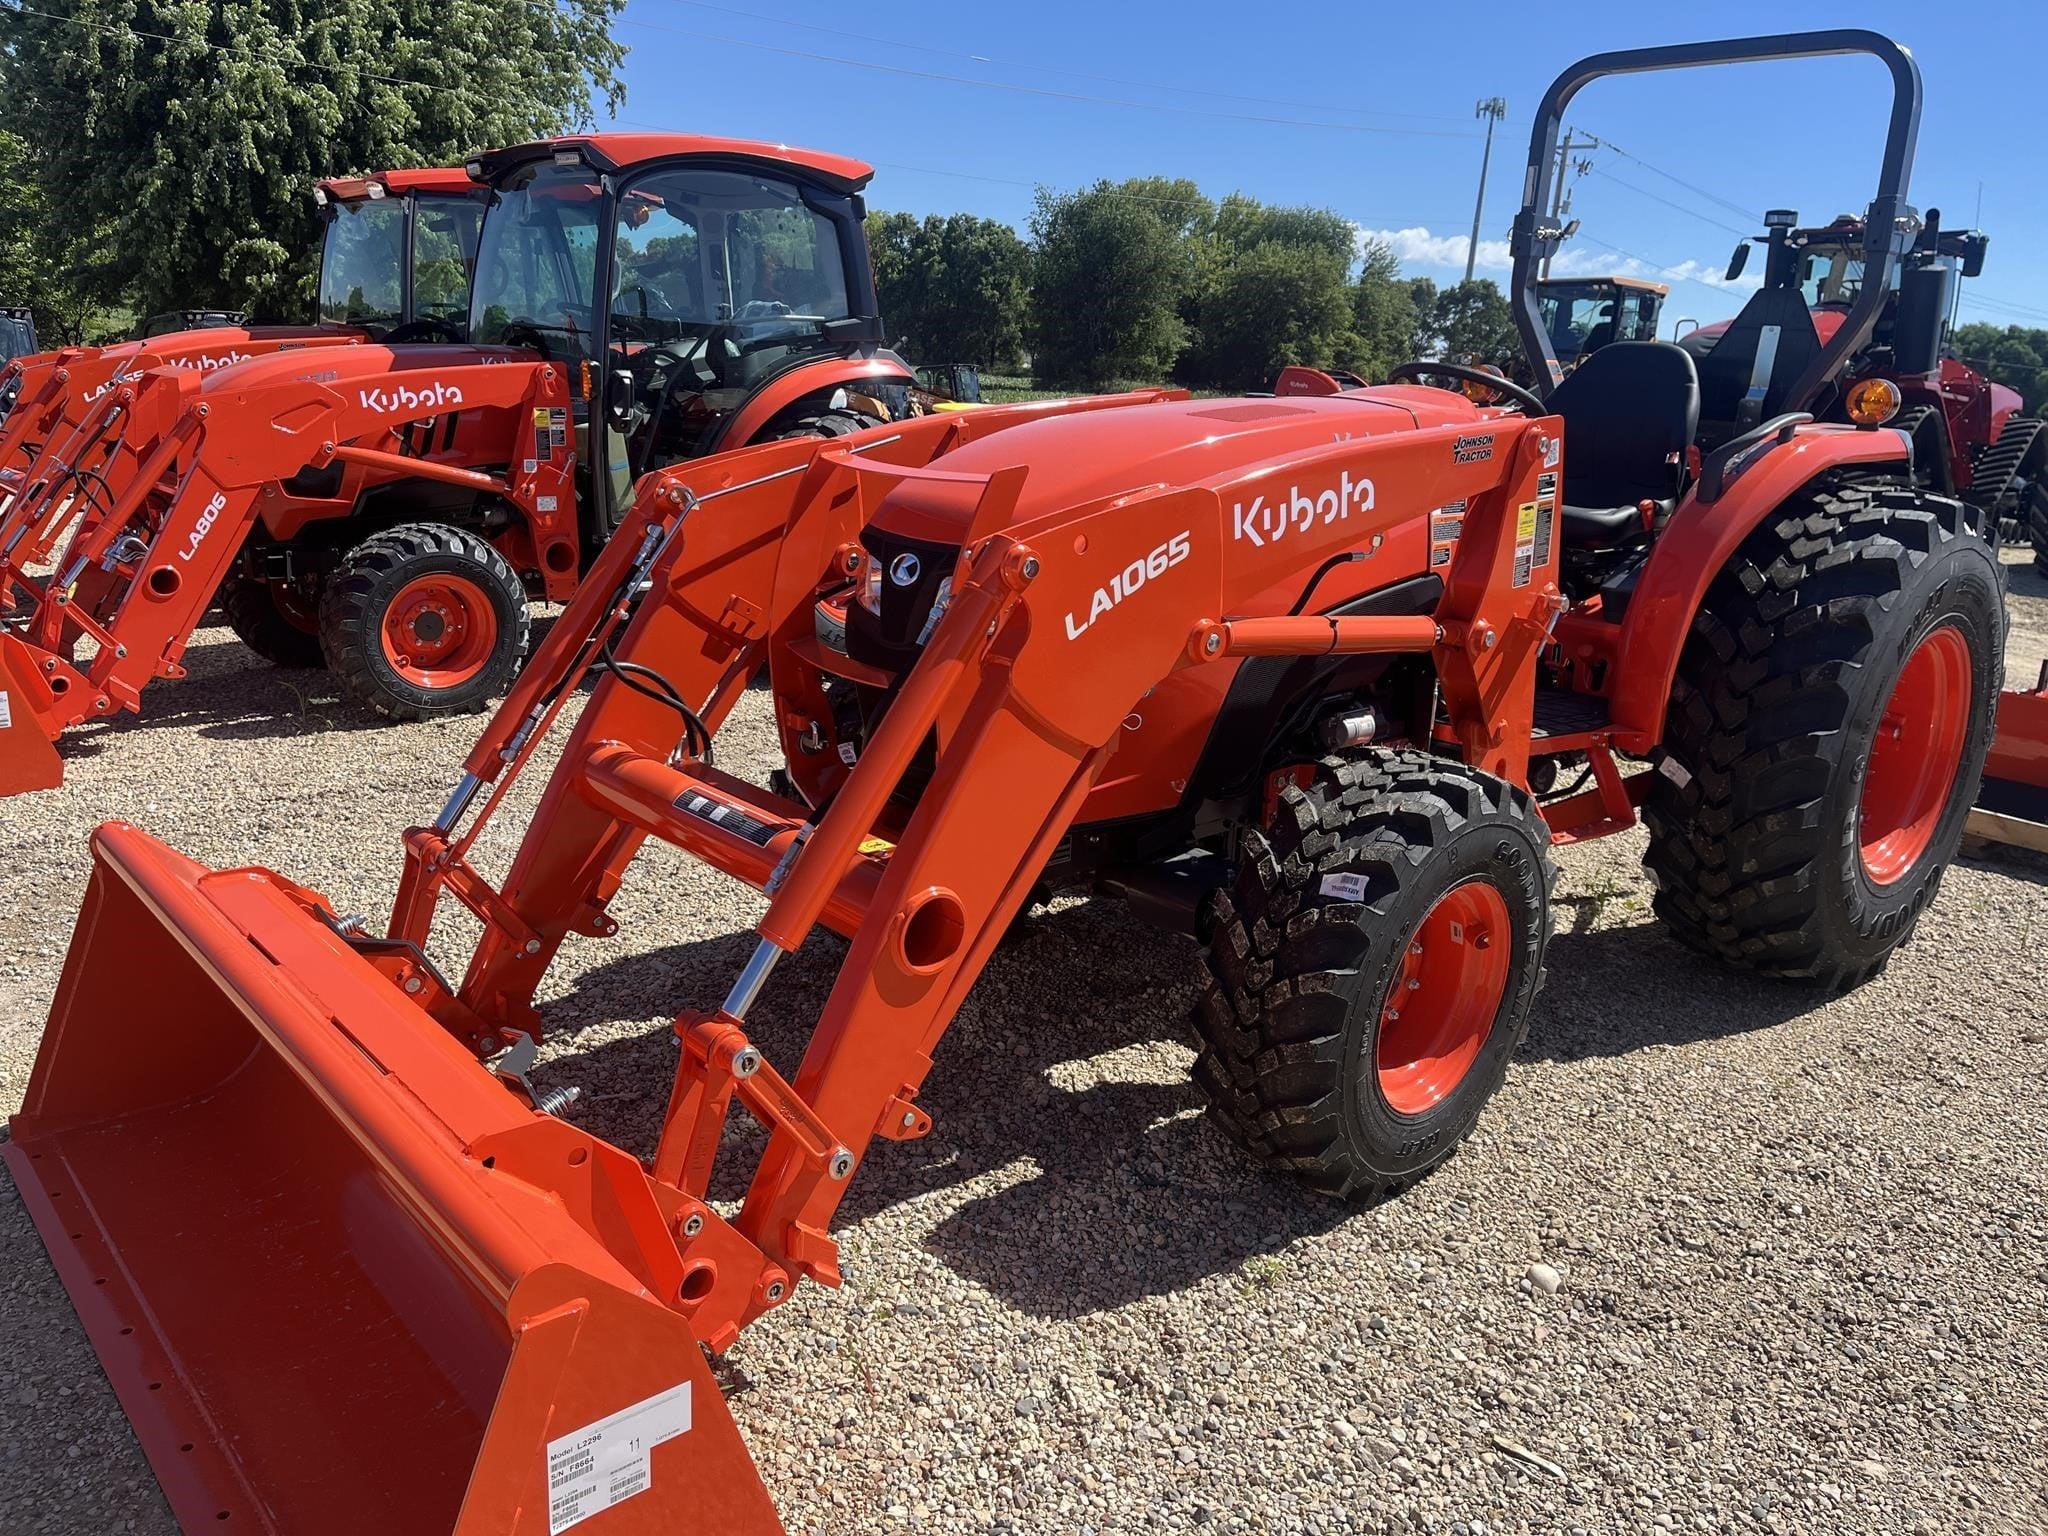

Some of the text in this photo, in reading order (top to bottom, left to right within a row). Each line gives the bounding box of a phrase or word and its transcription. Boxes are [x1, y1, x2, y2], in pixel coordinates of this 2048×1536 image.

[359, 382, 463, 413] Kubota
[1453, 434, 1495, 450] JOHNSON
[1453, 449, 1493, 464] TRACTOR
[1234, 470, 1375, 547] Kubota
[178, 491, 227, 561] LA806
[1065, 530, 1190, 641] LA1065
[1494, 839, 1540, 1032] GOODYEAR
[550, 1433, 602, 1462] Model L2296
[629, 1437, 640, 1453] 11
[551, 1470, 564, 1481] S/N
[570, 1455, 594, 1473] F8664
